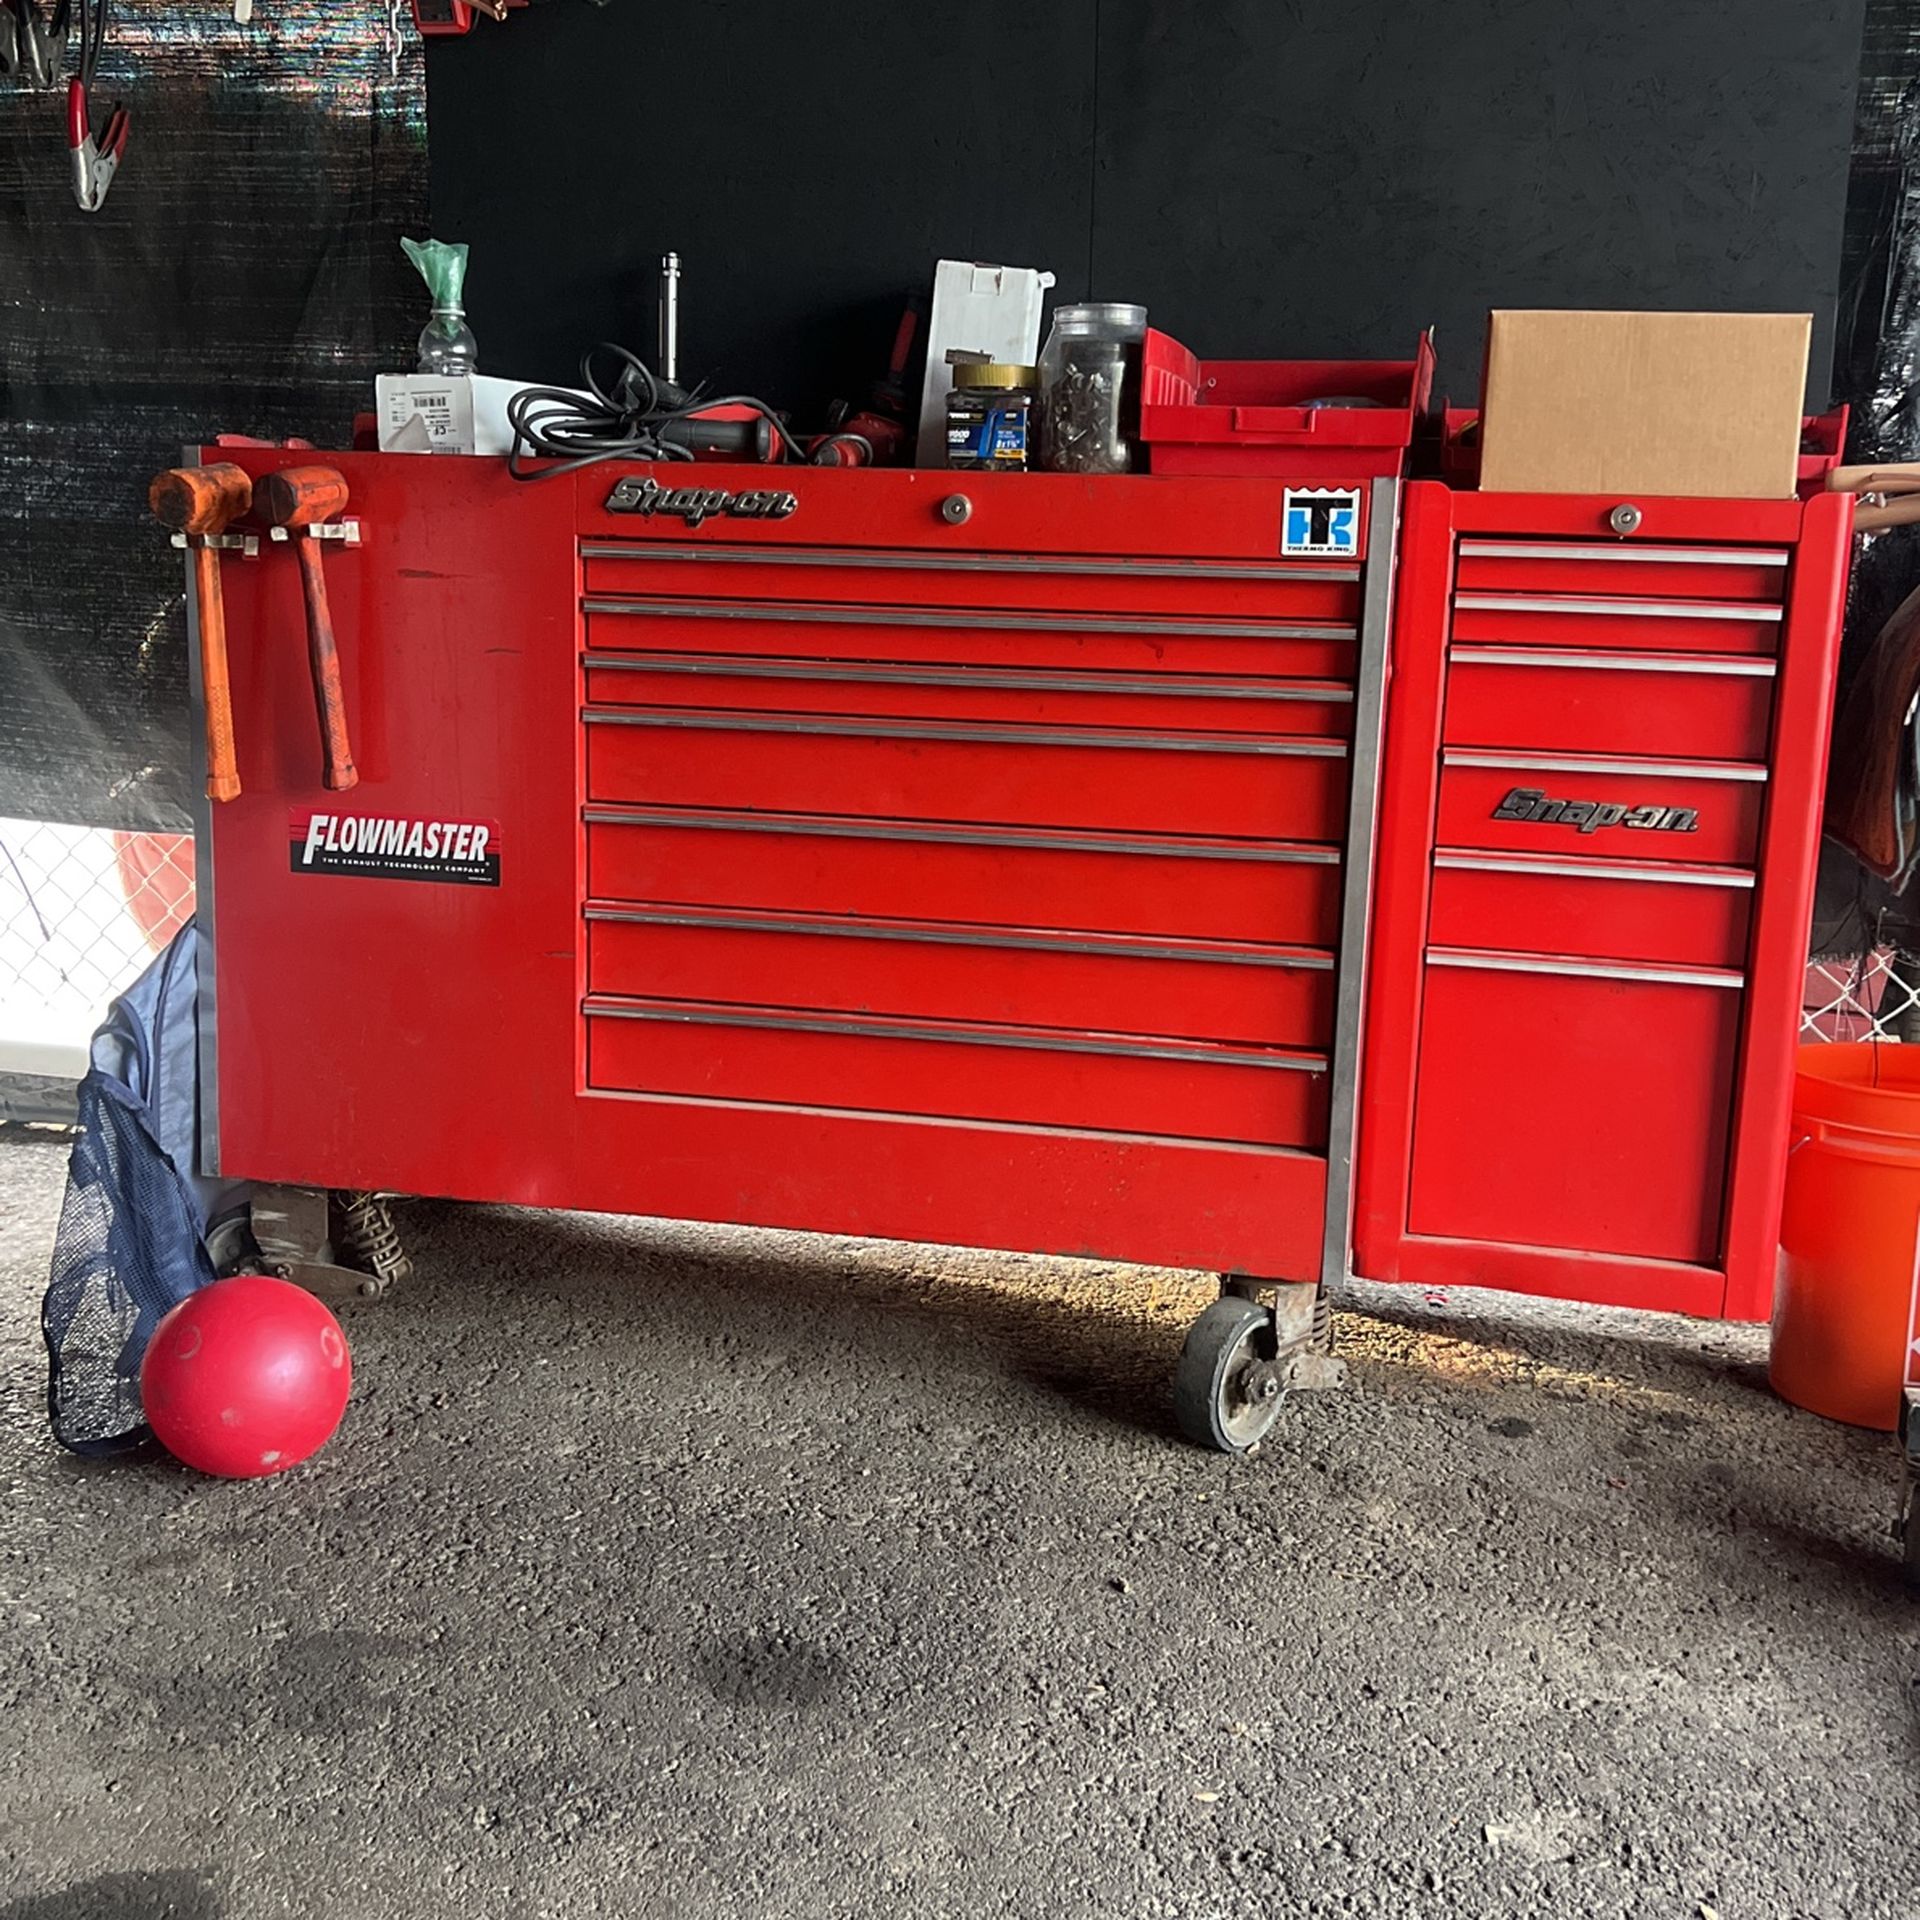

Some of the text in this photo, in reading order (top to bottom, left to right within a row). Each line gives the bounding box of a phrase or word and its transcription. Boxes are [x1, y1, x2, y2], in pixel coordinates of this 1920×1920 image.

[606, 476, 798, 528] Snap-on
[1492, 787, 1698, 833] Snap-on
[302, 814, 489, 865] FLOWMASTER
[342, 859, 381, 867] EXHAUST
[384, 861, 441, 871] TECHNOLOGY
[445, 865, 486, 874] COMPANY
